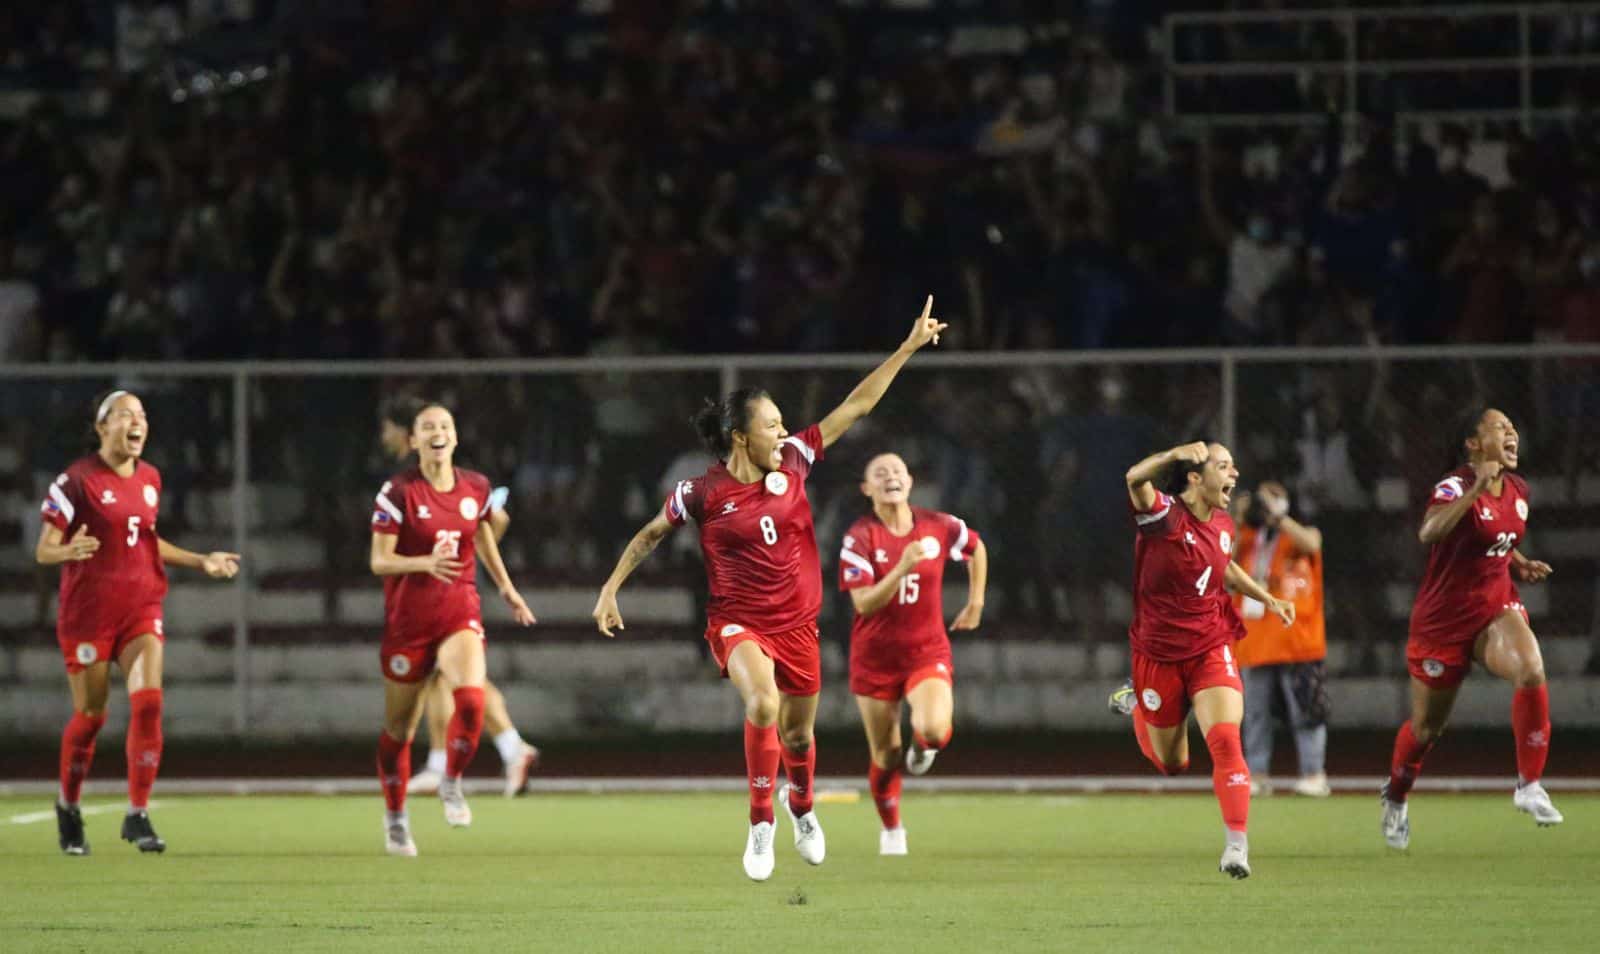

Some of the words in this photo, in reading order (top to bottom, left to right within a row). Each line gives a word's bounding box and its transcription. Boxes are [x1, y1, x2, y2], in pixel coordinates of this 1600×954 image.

[127, 515, 141, 547] 5
[435, 529, 462, 558] 25
[759, 515, 778, 546] 8
[1486, 532, 1517, 557] 26
[898, 573, 921, 605] 15
[1195, 565, 1212, 596] 4
